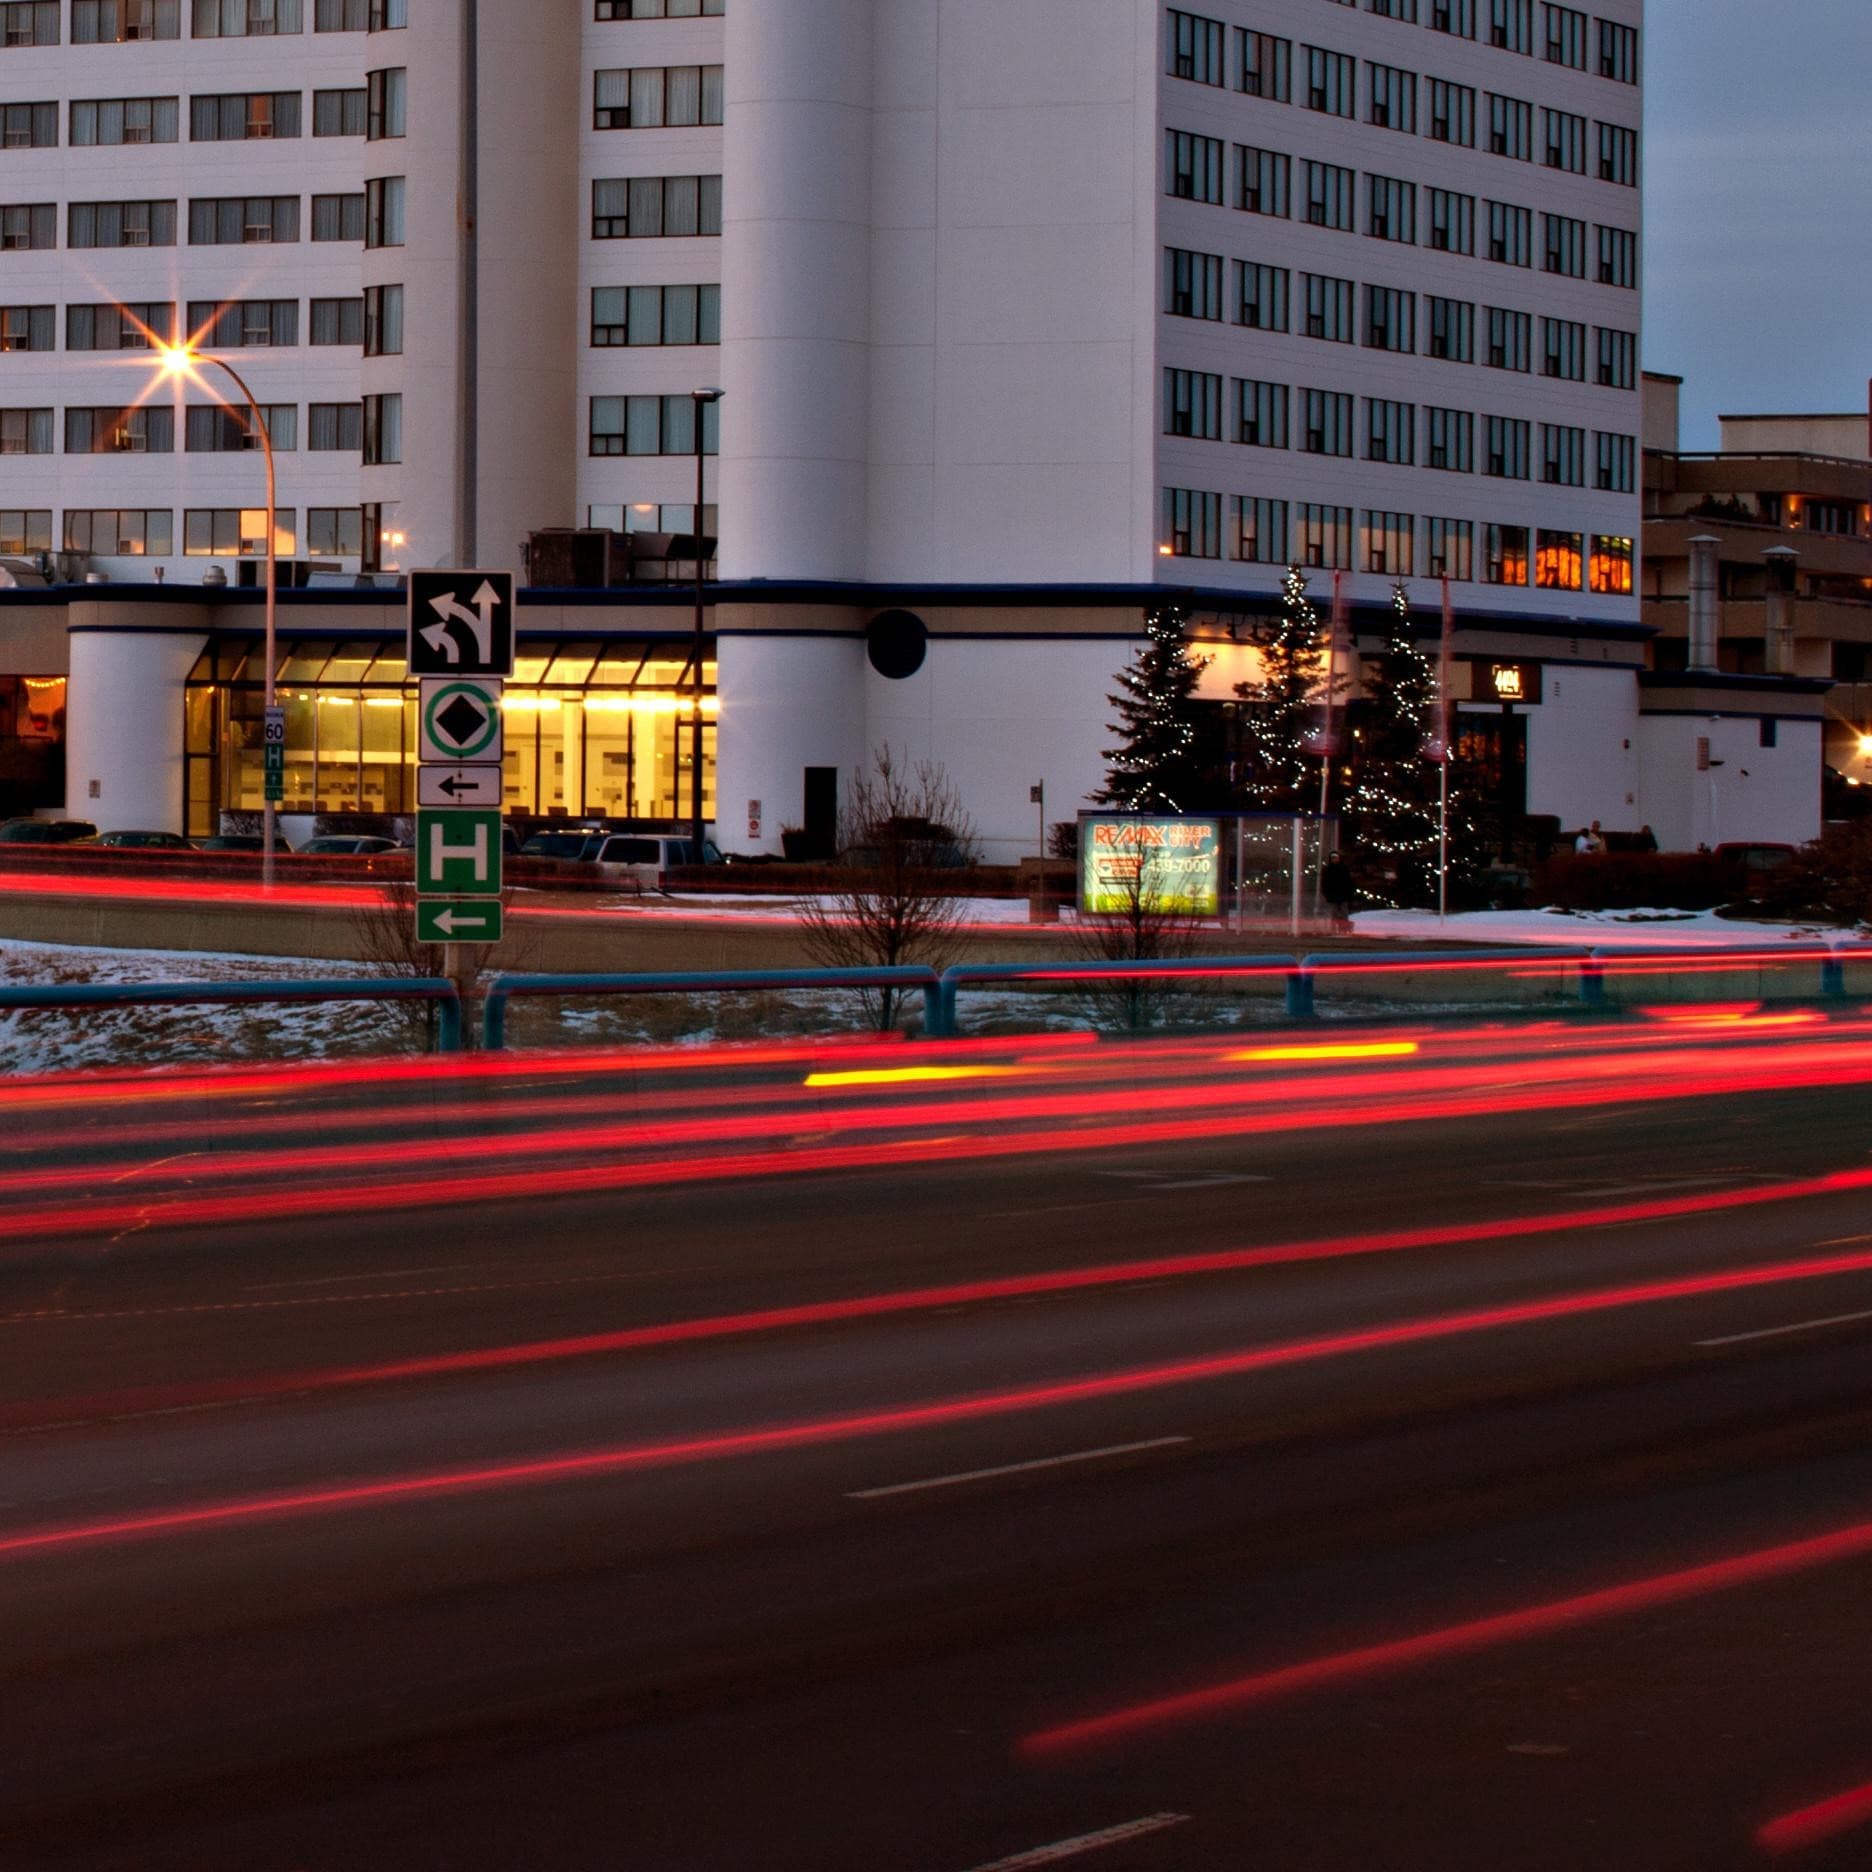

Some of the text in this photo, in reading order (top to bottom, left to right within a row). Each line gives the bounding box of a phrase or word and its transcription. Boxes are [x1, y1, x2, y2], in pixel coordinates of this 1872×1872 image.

[266, 723, 283, 740] 60
[268, 747, 280, 768] H
[430, 823, 488, 881] H
